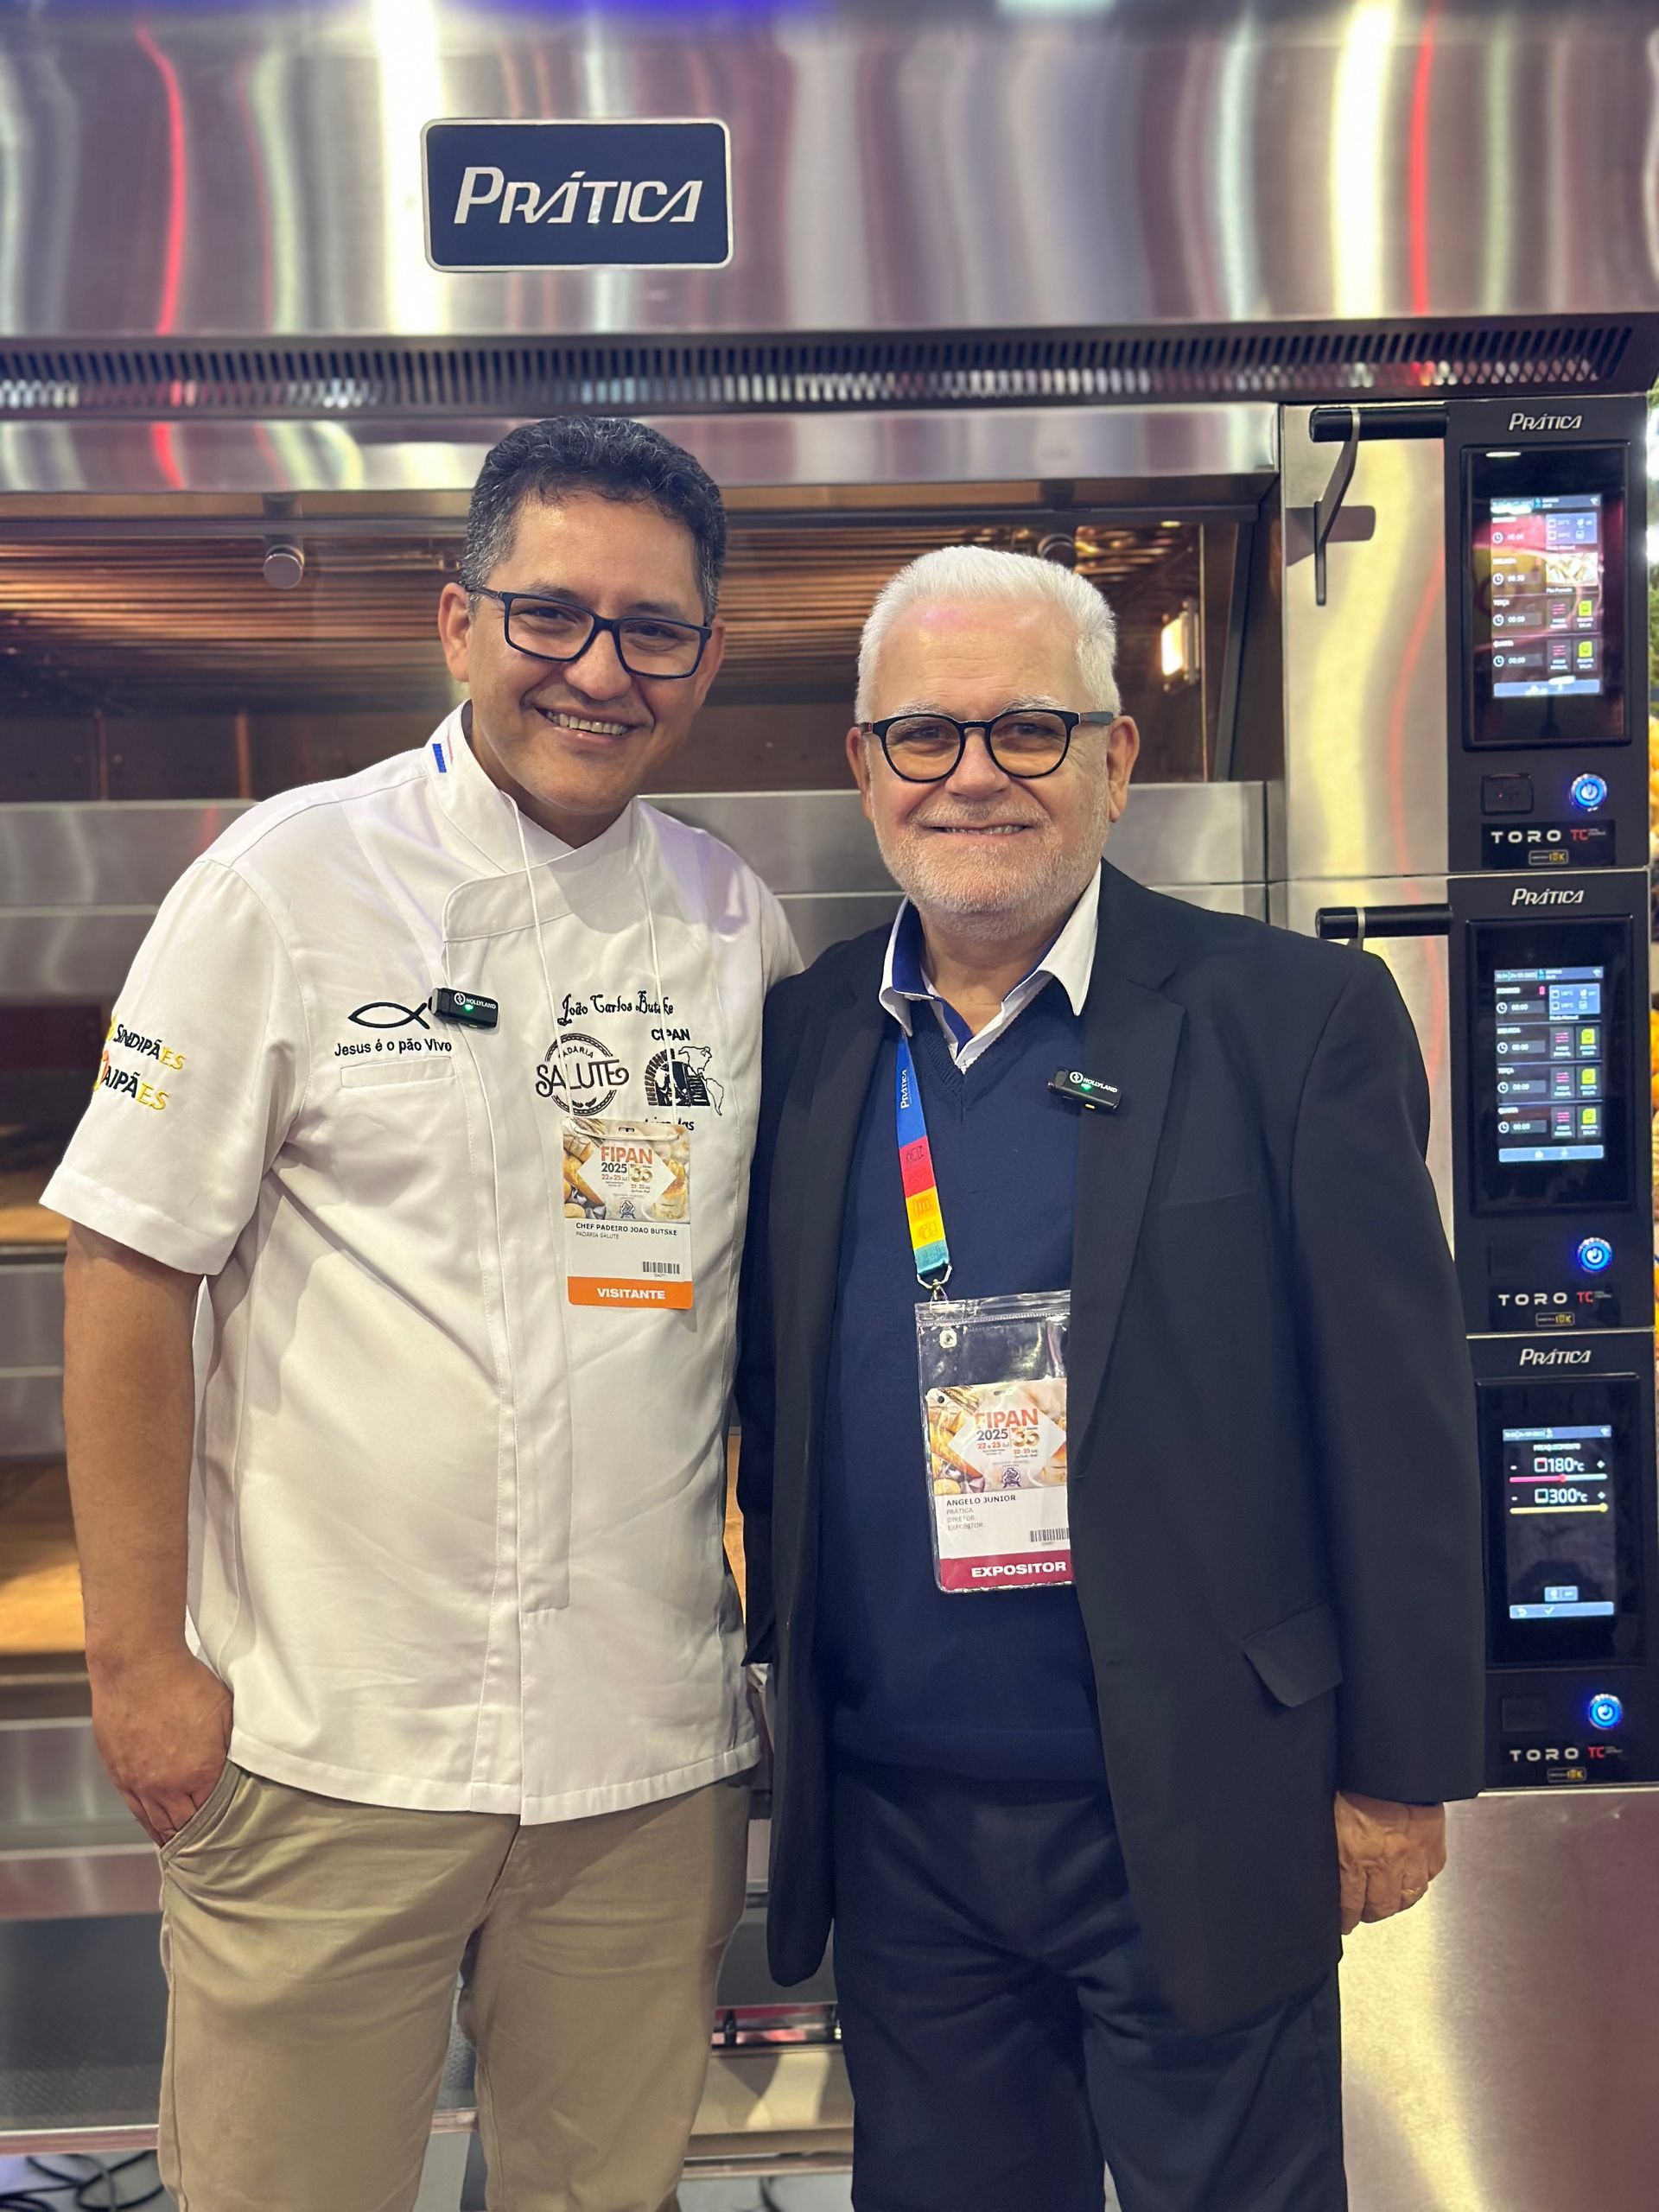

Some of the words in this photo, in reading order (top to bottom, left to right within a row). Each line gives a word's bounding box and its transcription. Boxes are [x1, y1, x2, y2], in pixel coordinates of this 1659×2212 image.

[454, 167, 703, 224] PRÁTICA
[1491, 830, 1561, 843] TORO
[1570, 829, 1588, 842] TC
[467, 997, 497, 1009] HOLLYLAND
[589, 994, 632, 1014] Carlos
[334, 1043, 372, 1056] Jesus
[375, 1039, 383, 1052] é
[386, 1041, 395, 1051] o
[398, 1038, 422, 1054] pão
[424, 1038, 452, 1052] Vivo
[558, 1046, 594, 1058] ADARIA
[1083, 1077, 1118, 1093] HOLLYLAND
[601, 1147, 652, 1164] FIPAN
[601, 1162, 627, 1173] 2025
[596, 1224, 628, 1232] PADEIRO
[597, 1287, 666, 1300] VISITANTE
[1498, 1293, 1567, 1306] TORO
[1576, 1291, 1593, 1304] TC
[976, 1428, 1008, 1441] 2025
[946, 1497, 981, 1506] ANGELO
[983, 1495, 1016, 1503] JUNIOR
[971, 1561, 1067, 1578] EXPOSITOR
[1510, 1747, 1579, 1762] TORO
[1587, 1746, 1605, 1758] TC
